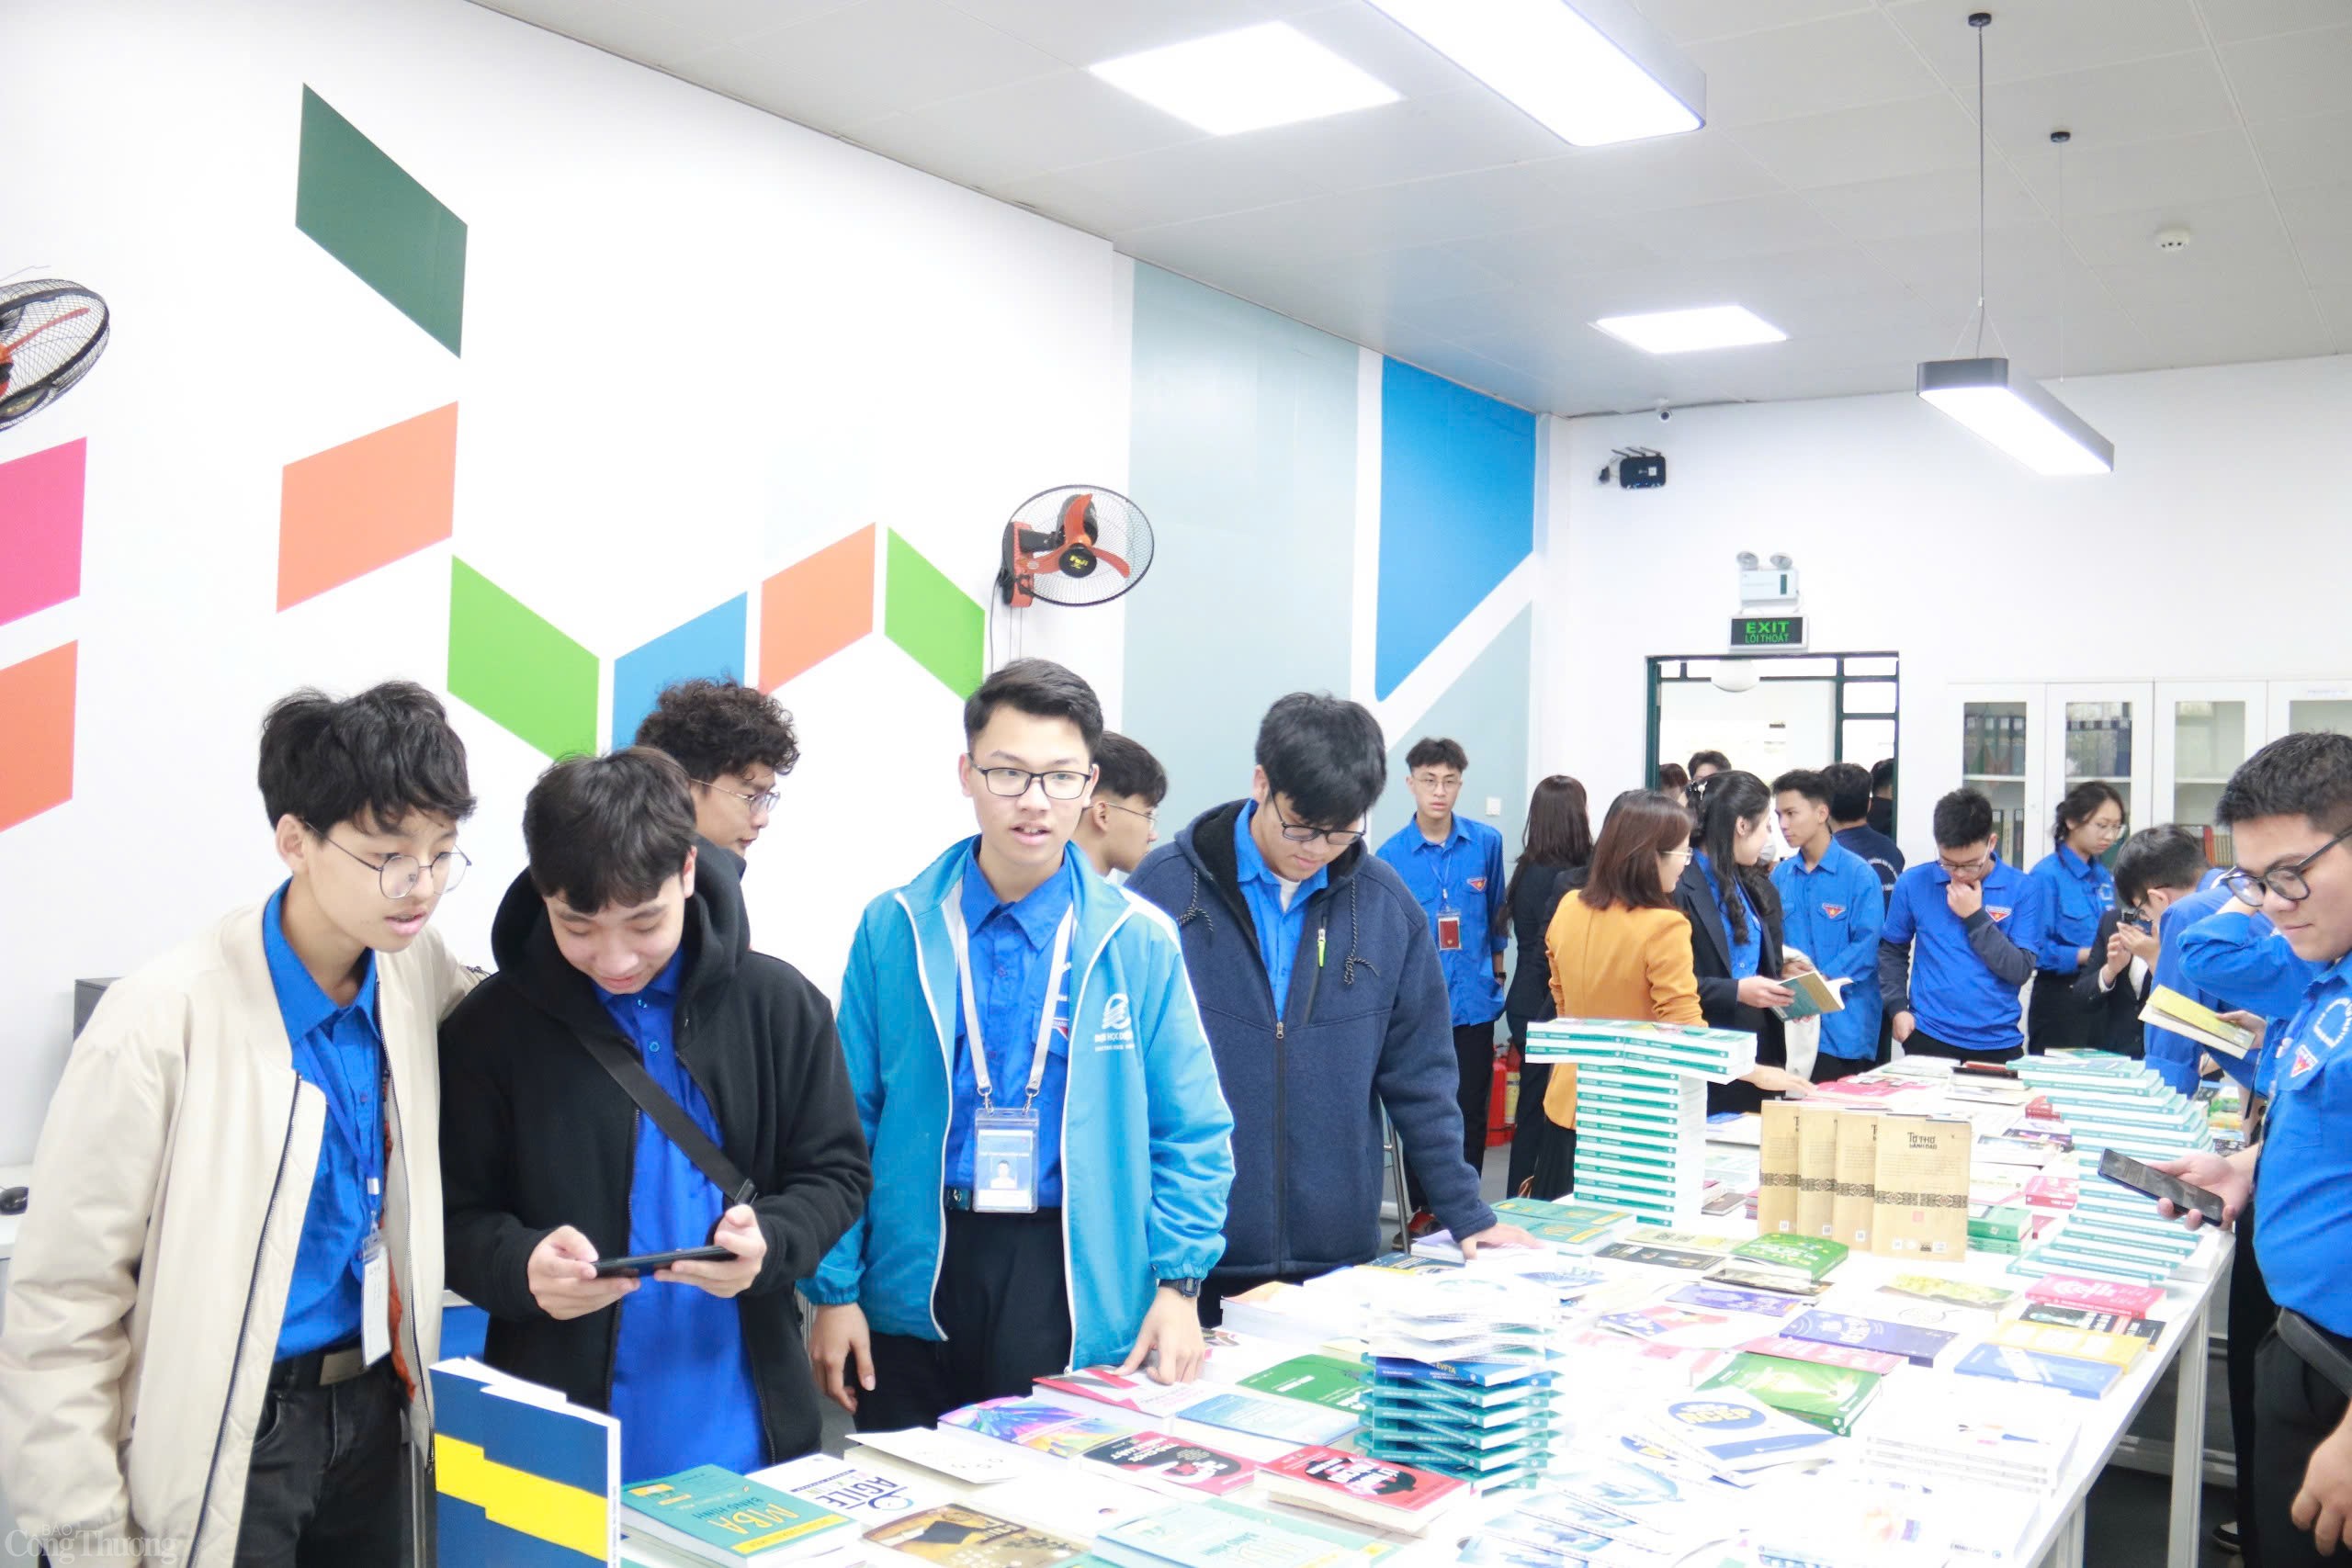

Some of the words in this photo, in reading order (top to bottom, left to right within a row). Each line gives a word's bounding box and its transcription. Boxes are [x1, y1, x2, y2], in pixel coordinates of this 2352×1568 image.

[1746, 621, 1790, 634] EXIT
[815, 1476, 899, 1507] AGILE
[707, 1503, 800, 1535] MBA
